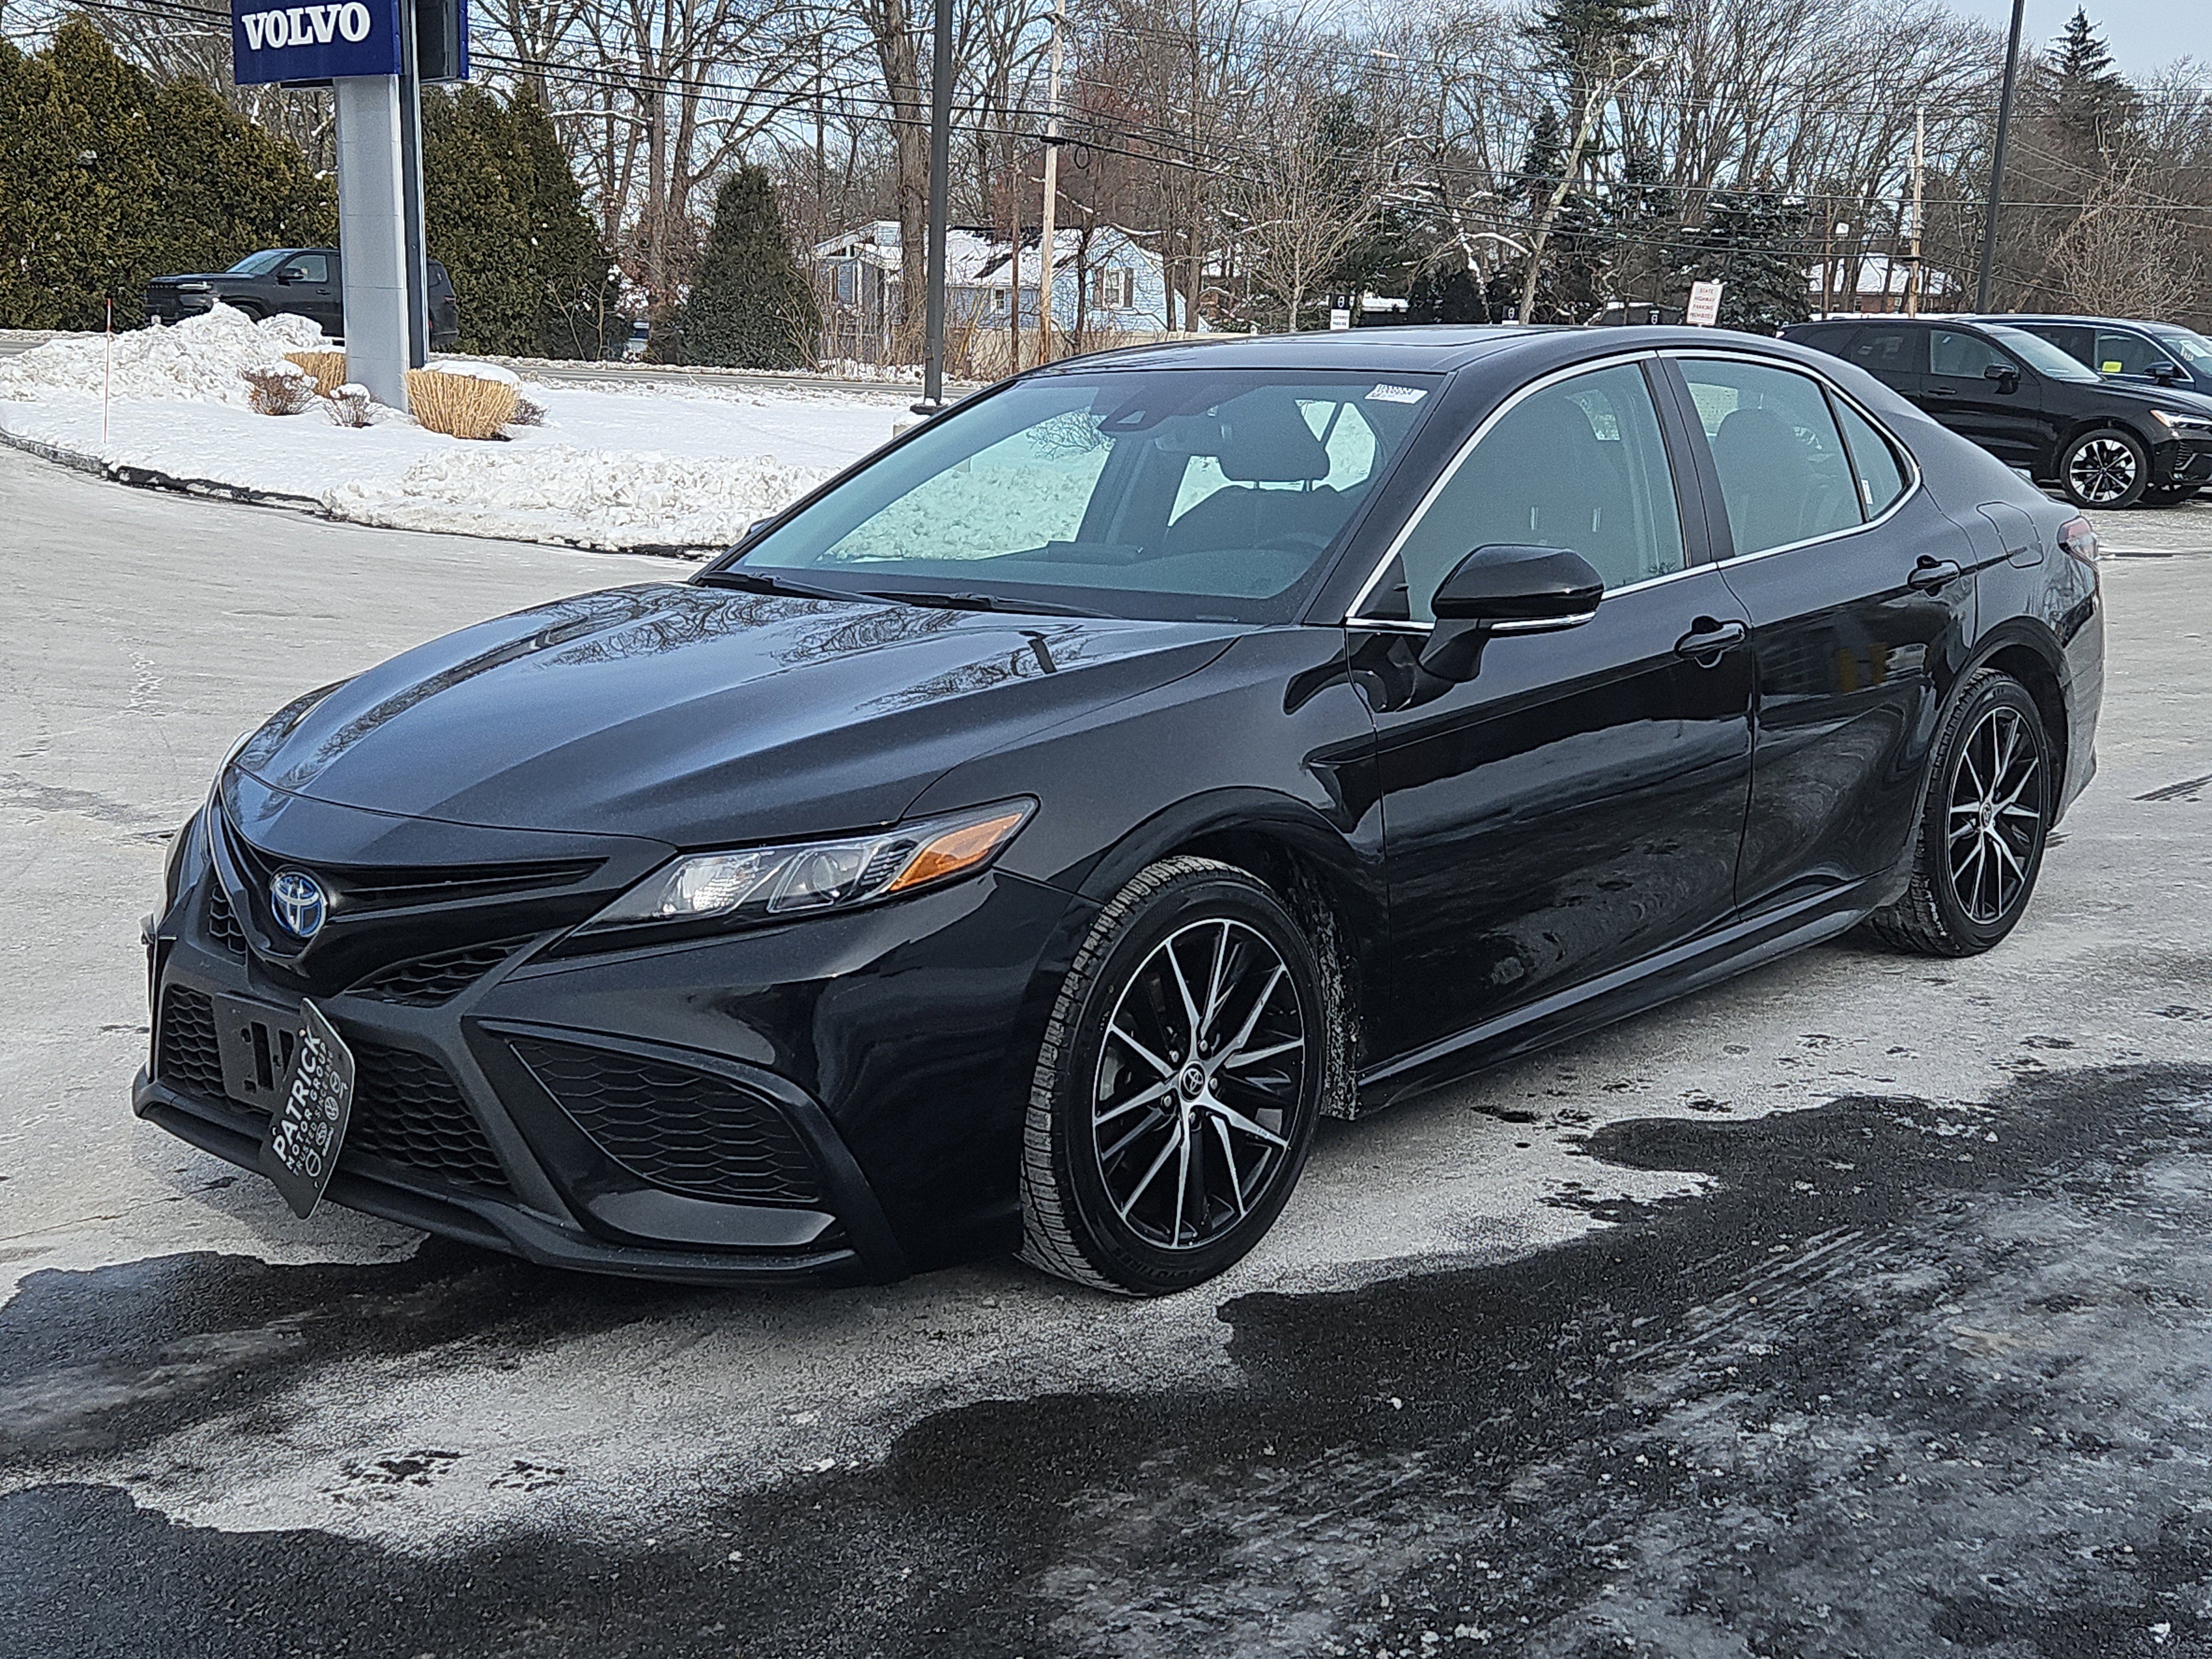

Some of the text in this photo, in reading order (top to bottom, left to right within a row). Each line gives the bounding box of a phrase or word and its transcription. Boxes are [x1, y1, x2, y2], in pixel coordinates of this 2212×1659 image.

[242, 2, 370, 50] VOLVO
[272, 1025, 321, 1161] PATRICK
[286, 1042, 326, 1170] MOTOR GROUP
[293, 1122, 317, 1176] TRUSTED
